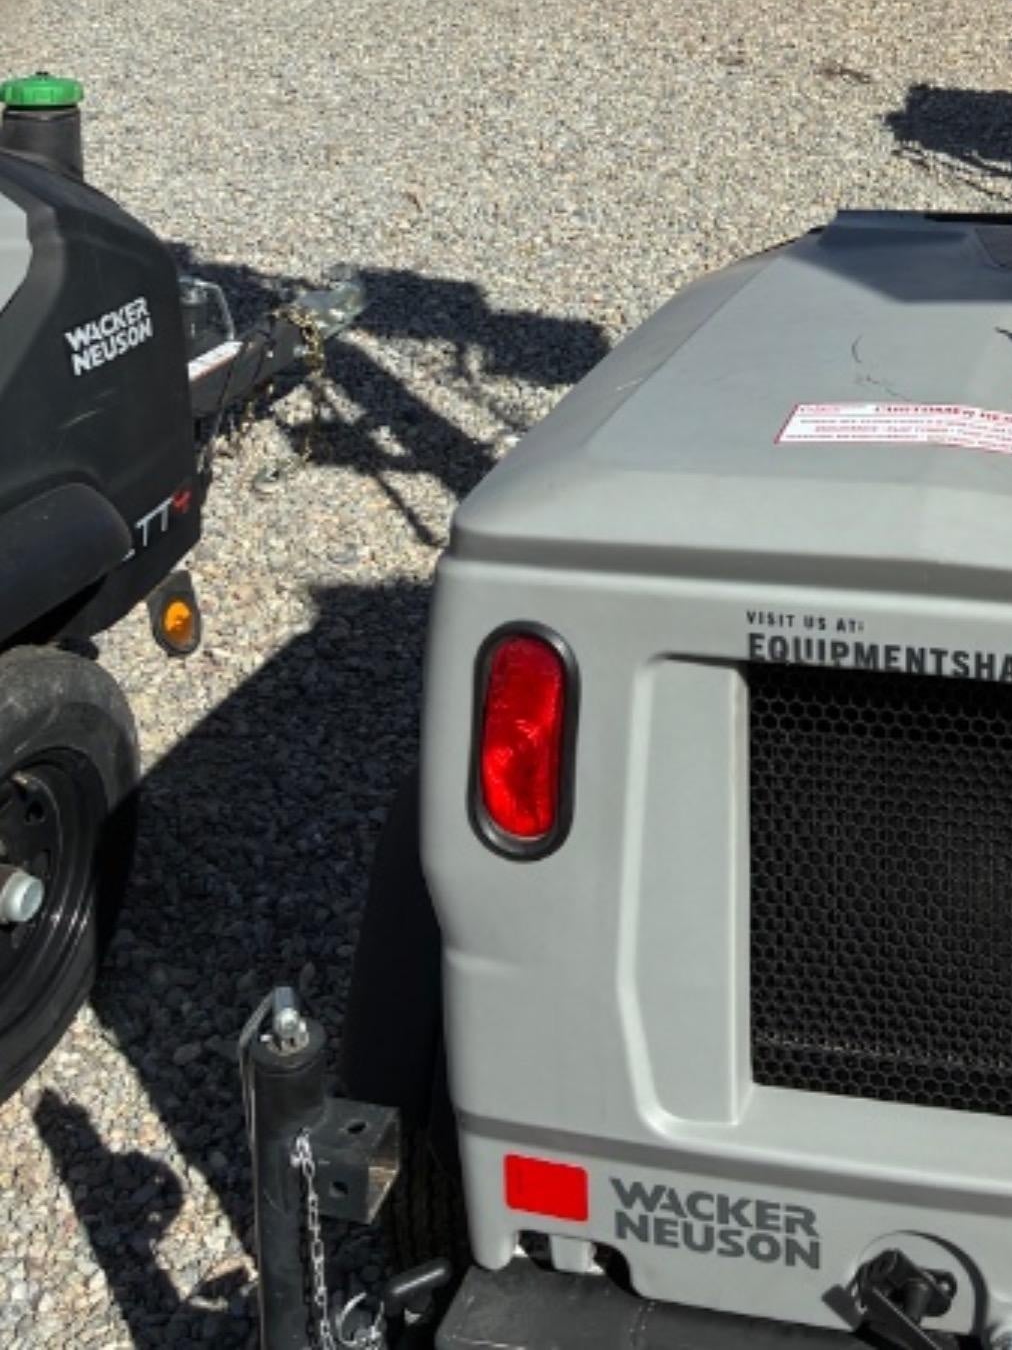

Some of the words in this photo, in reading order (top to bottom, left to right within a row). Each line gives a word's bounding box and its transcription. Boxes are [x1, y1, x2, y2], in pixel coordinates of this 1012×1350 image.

[64, 296, 149, 351] WACKER
[71, 319, 153, 377] NEUSON
[746, 611, 795, 629] VISIT
[804, 615, 826, 631] US
[608, 1176, 820, 1239] WACKER
[614, 1209, 820, 1270] NEUSON
